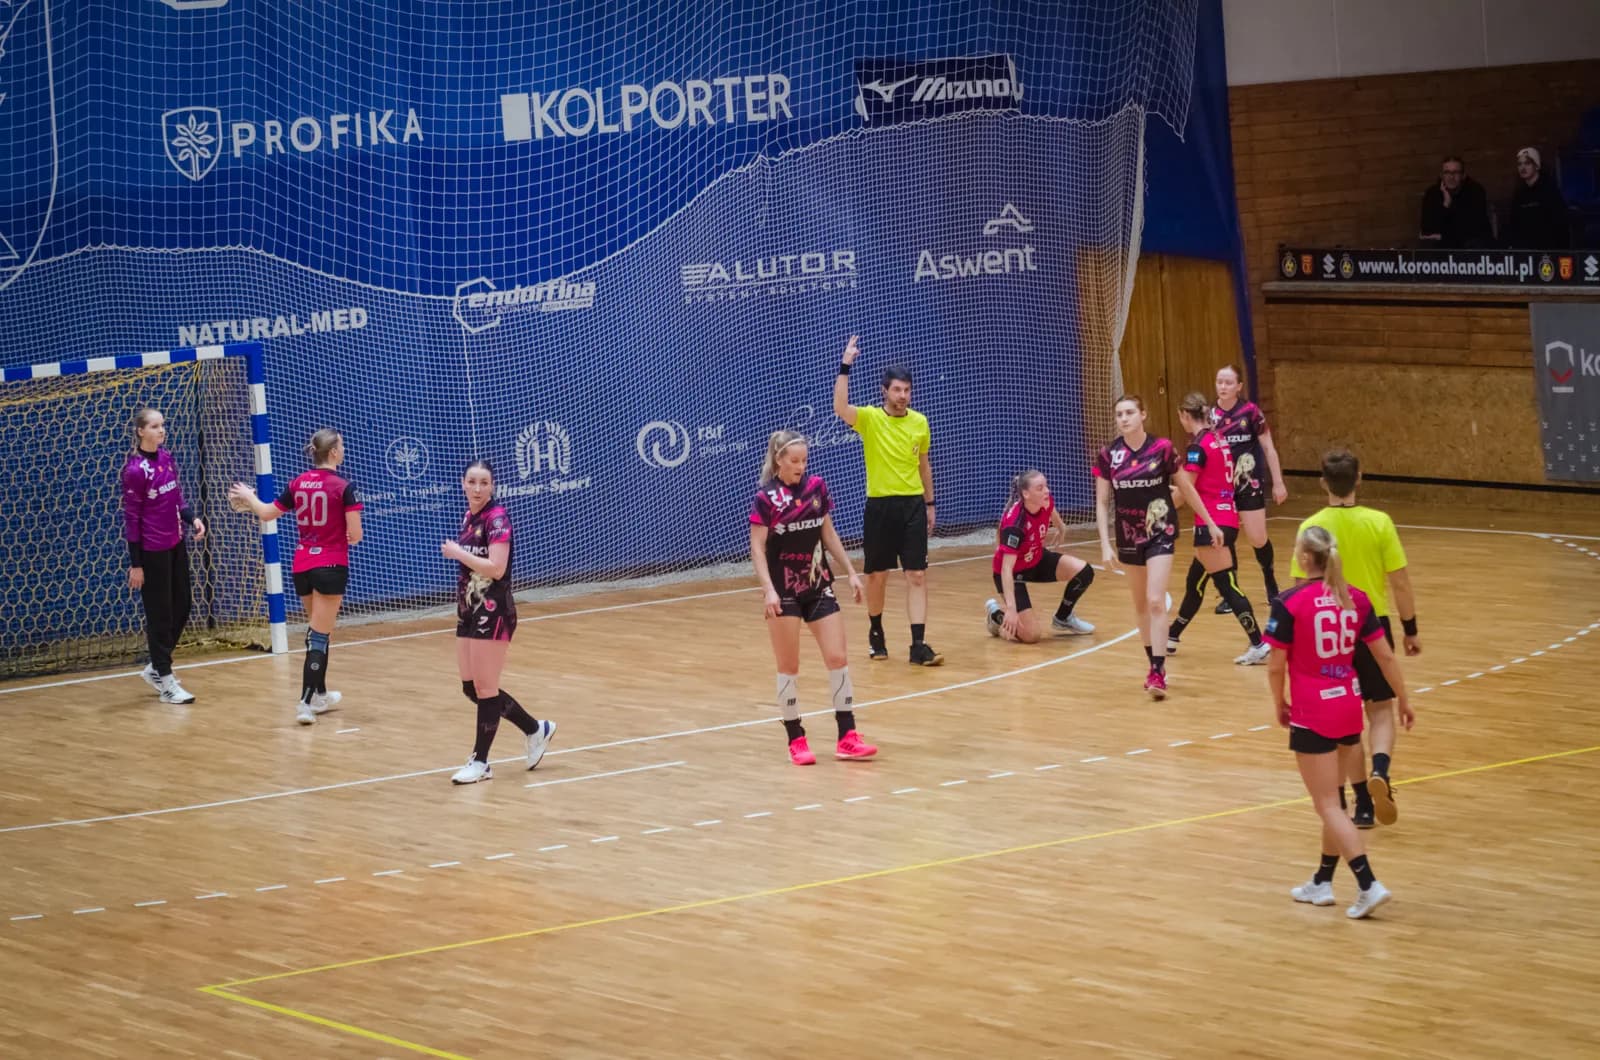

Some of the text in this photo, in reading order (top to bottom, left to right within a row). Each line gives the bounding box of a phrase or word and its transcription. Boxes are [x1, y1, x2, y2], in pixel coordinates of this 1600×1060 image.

[532, 73, 793, 138] KOLPORTER
[231, 108, 425, 158] PROFIKA
[914, 244, 1038, 283] Aswent
[1358, 253, 1534, 283] www.koronahandball.pl
[468, 278, 597, 309] endorfina
[178, 307, 369, 347] NATURAL-MED
[496, 476, 591, 499] Husar-Sport
[294, 491, 328, 527] 20
[1313, 610, 1358, 658] 66
